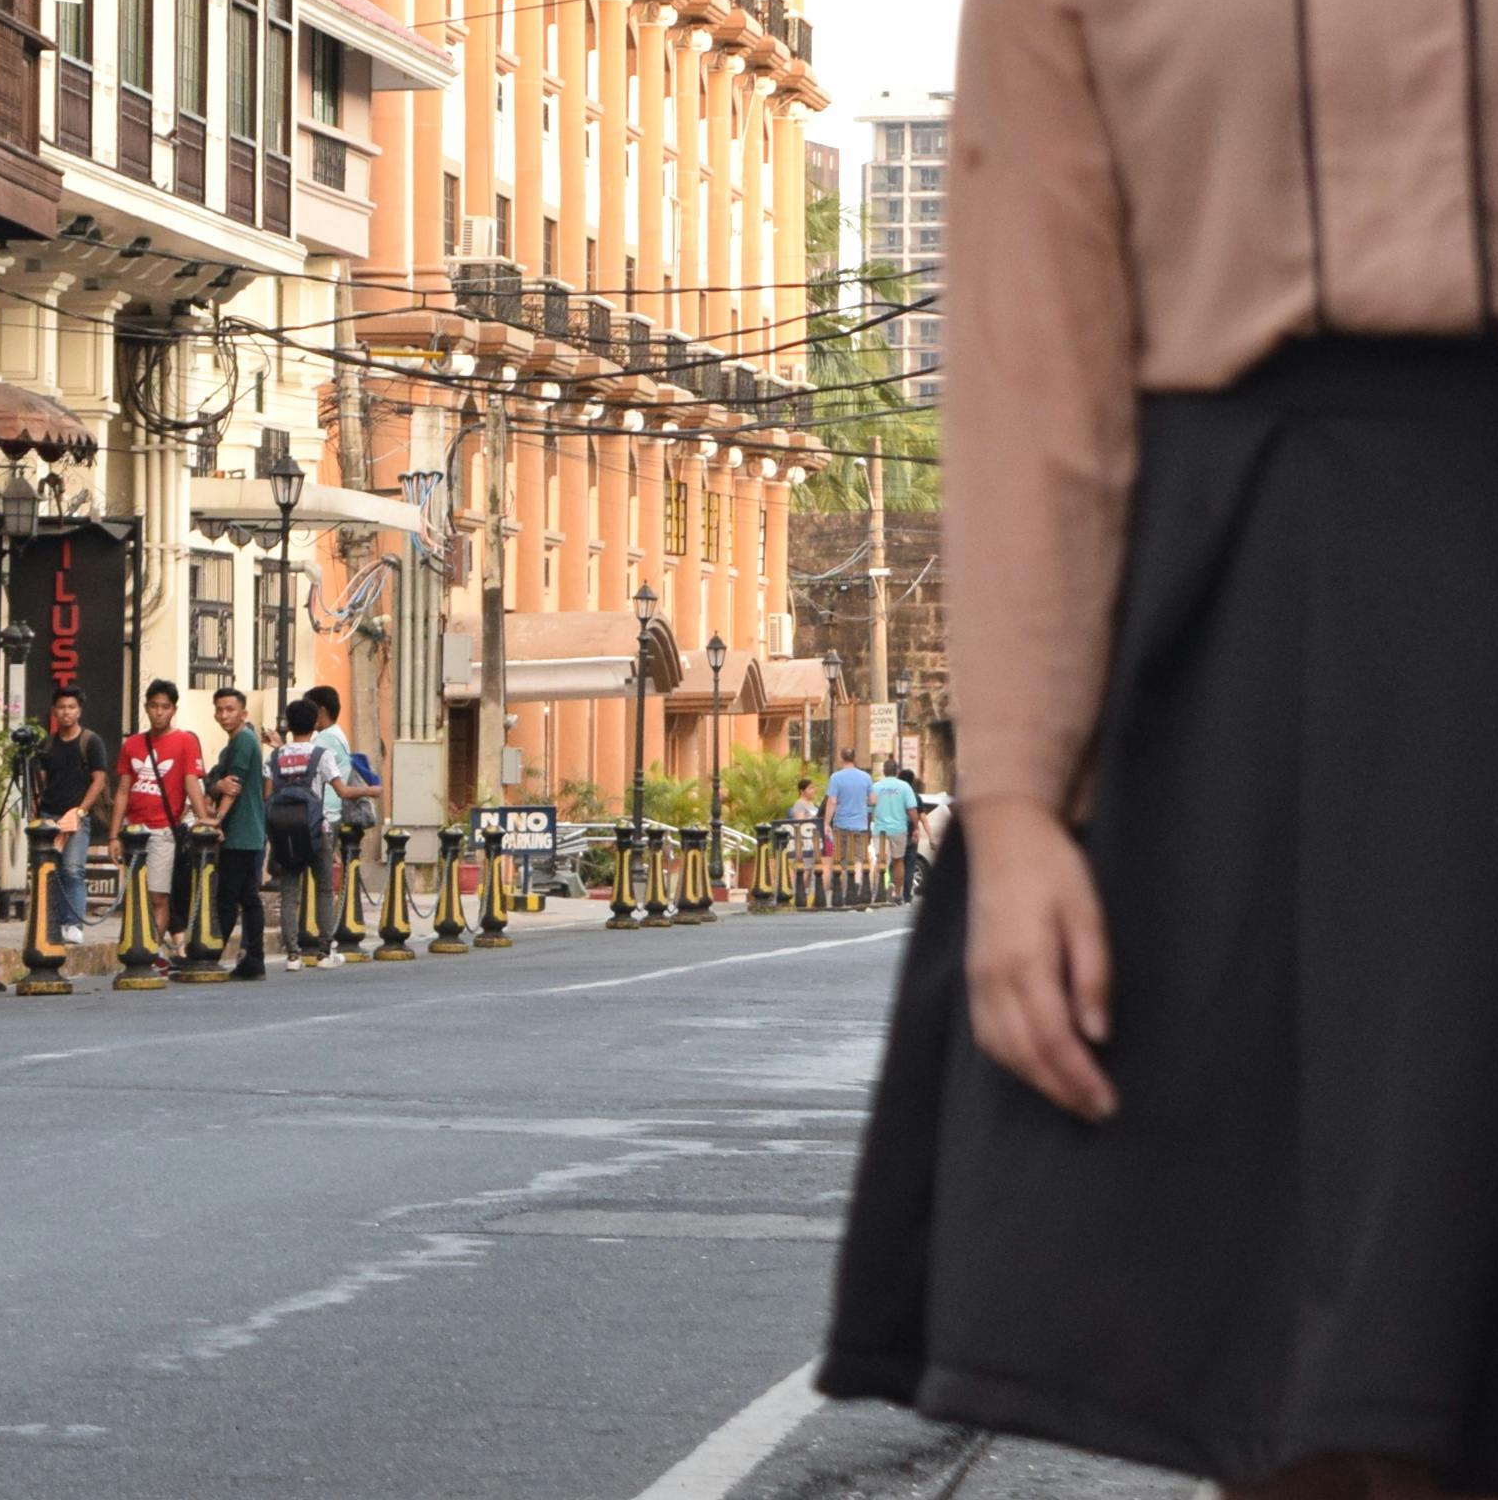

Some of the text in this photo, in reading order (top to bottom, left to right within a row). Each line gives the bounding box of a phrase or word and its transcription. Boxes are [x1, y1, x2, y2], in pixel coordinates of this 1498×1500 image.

[50, 538, 80, 734] ILUST
[506, 812, 548, 832] NO
[501, 832, 553, 850] PARKING
